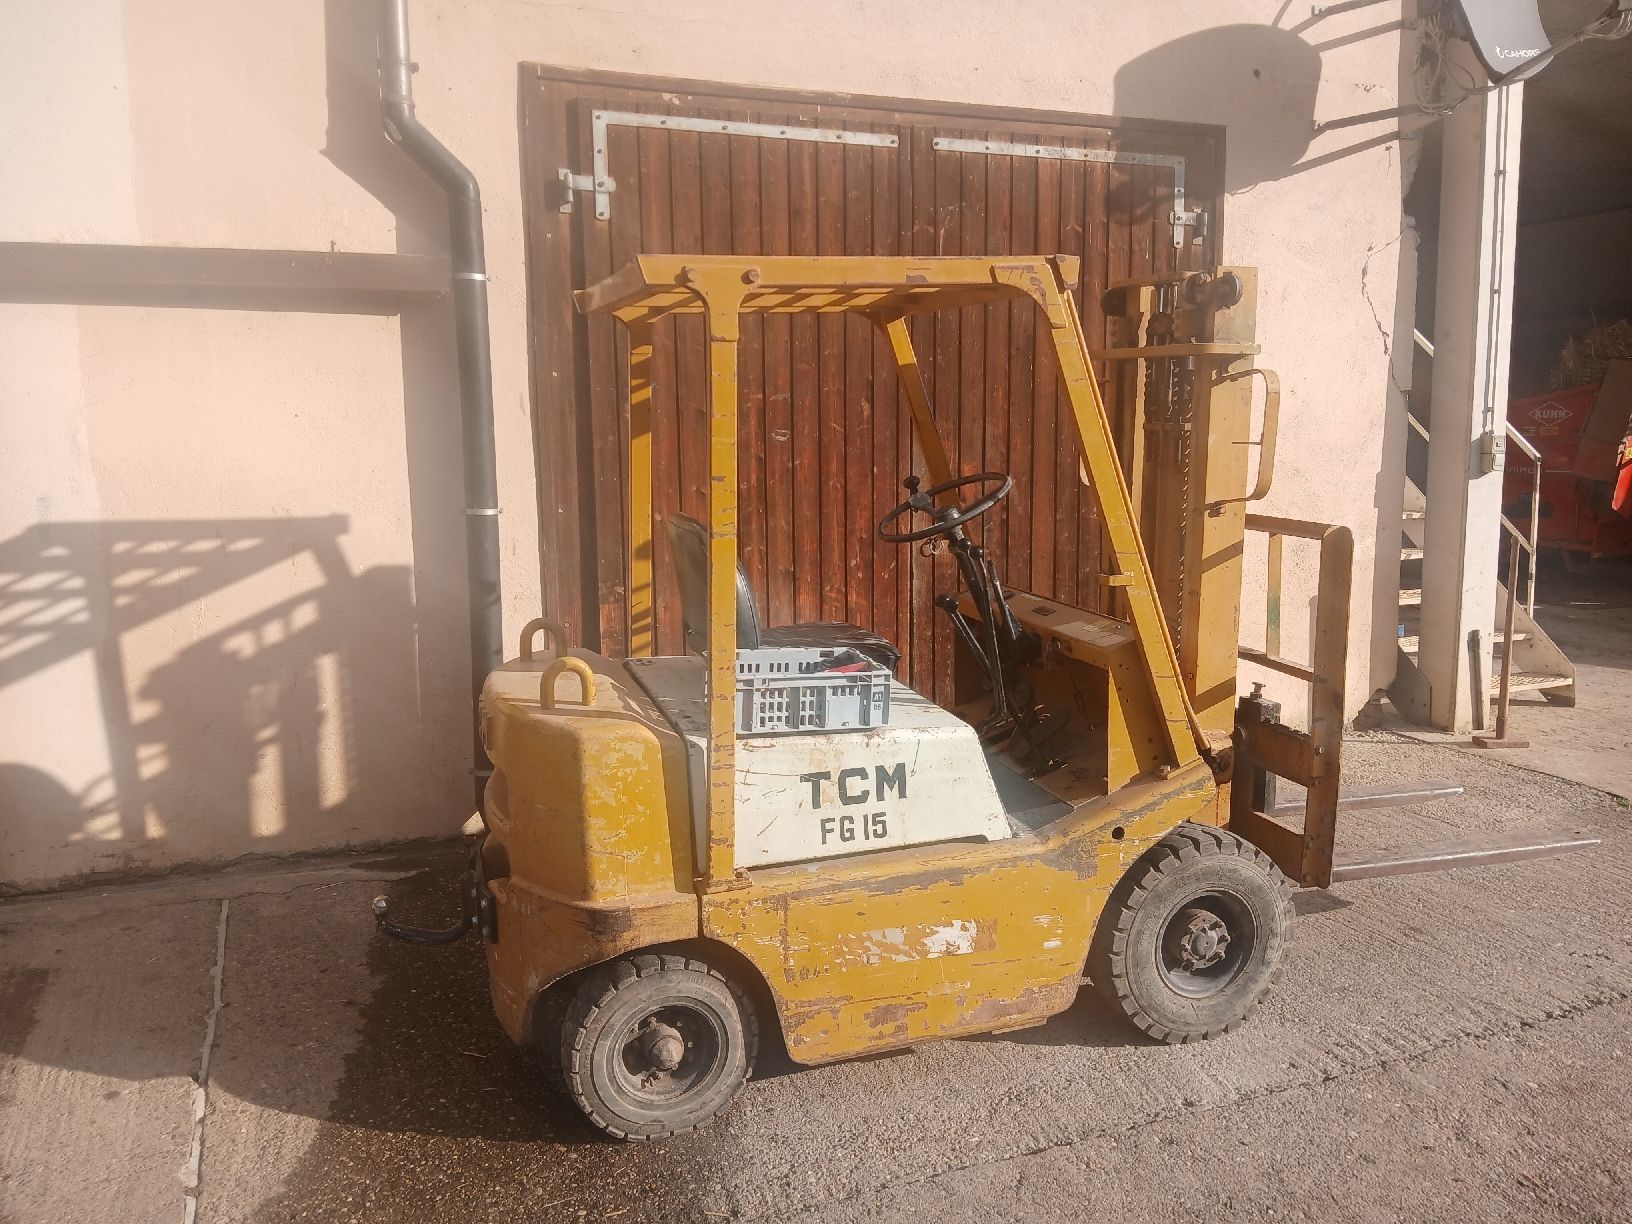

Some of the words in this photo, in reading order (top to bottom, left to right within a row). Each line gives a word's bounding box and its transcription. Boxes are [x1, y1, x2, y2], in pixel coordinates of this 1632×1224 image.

[1504, 48, 1541, 57] CAHORS
[1535, 409, 1567, 419] KUHN
[800, 762, 907, 810] TCM
